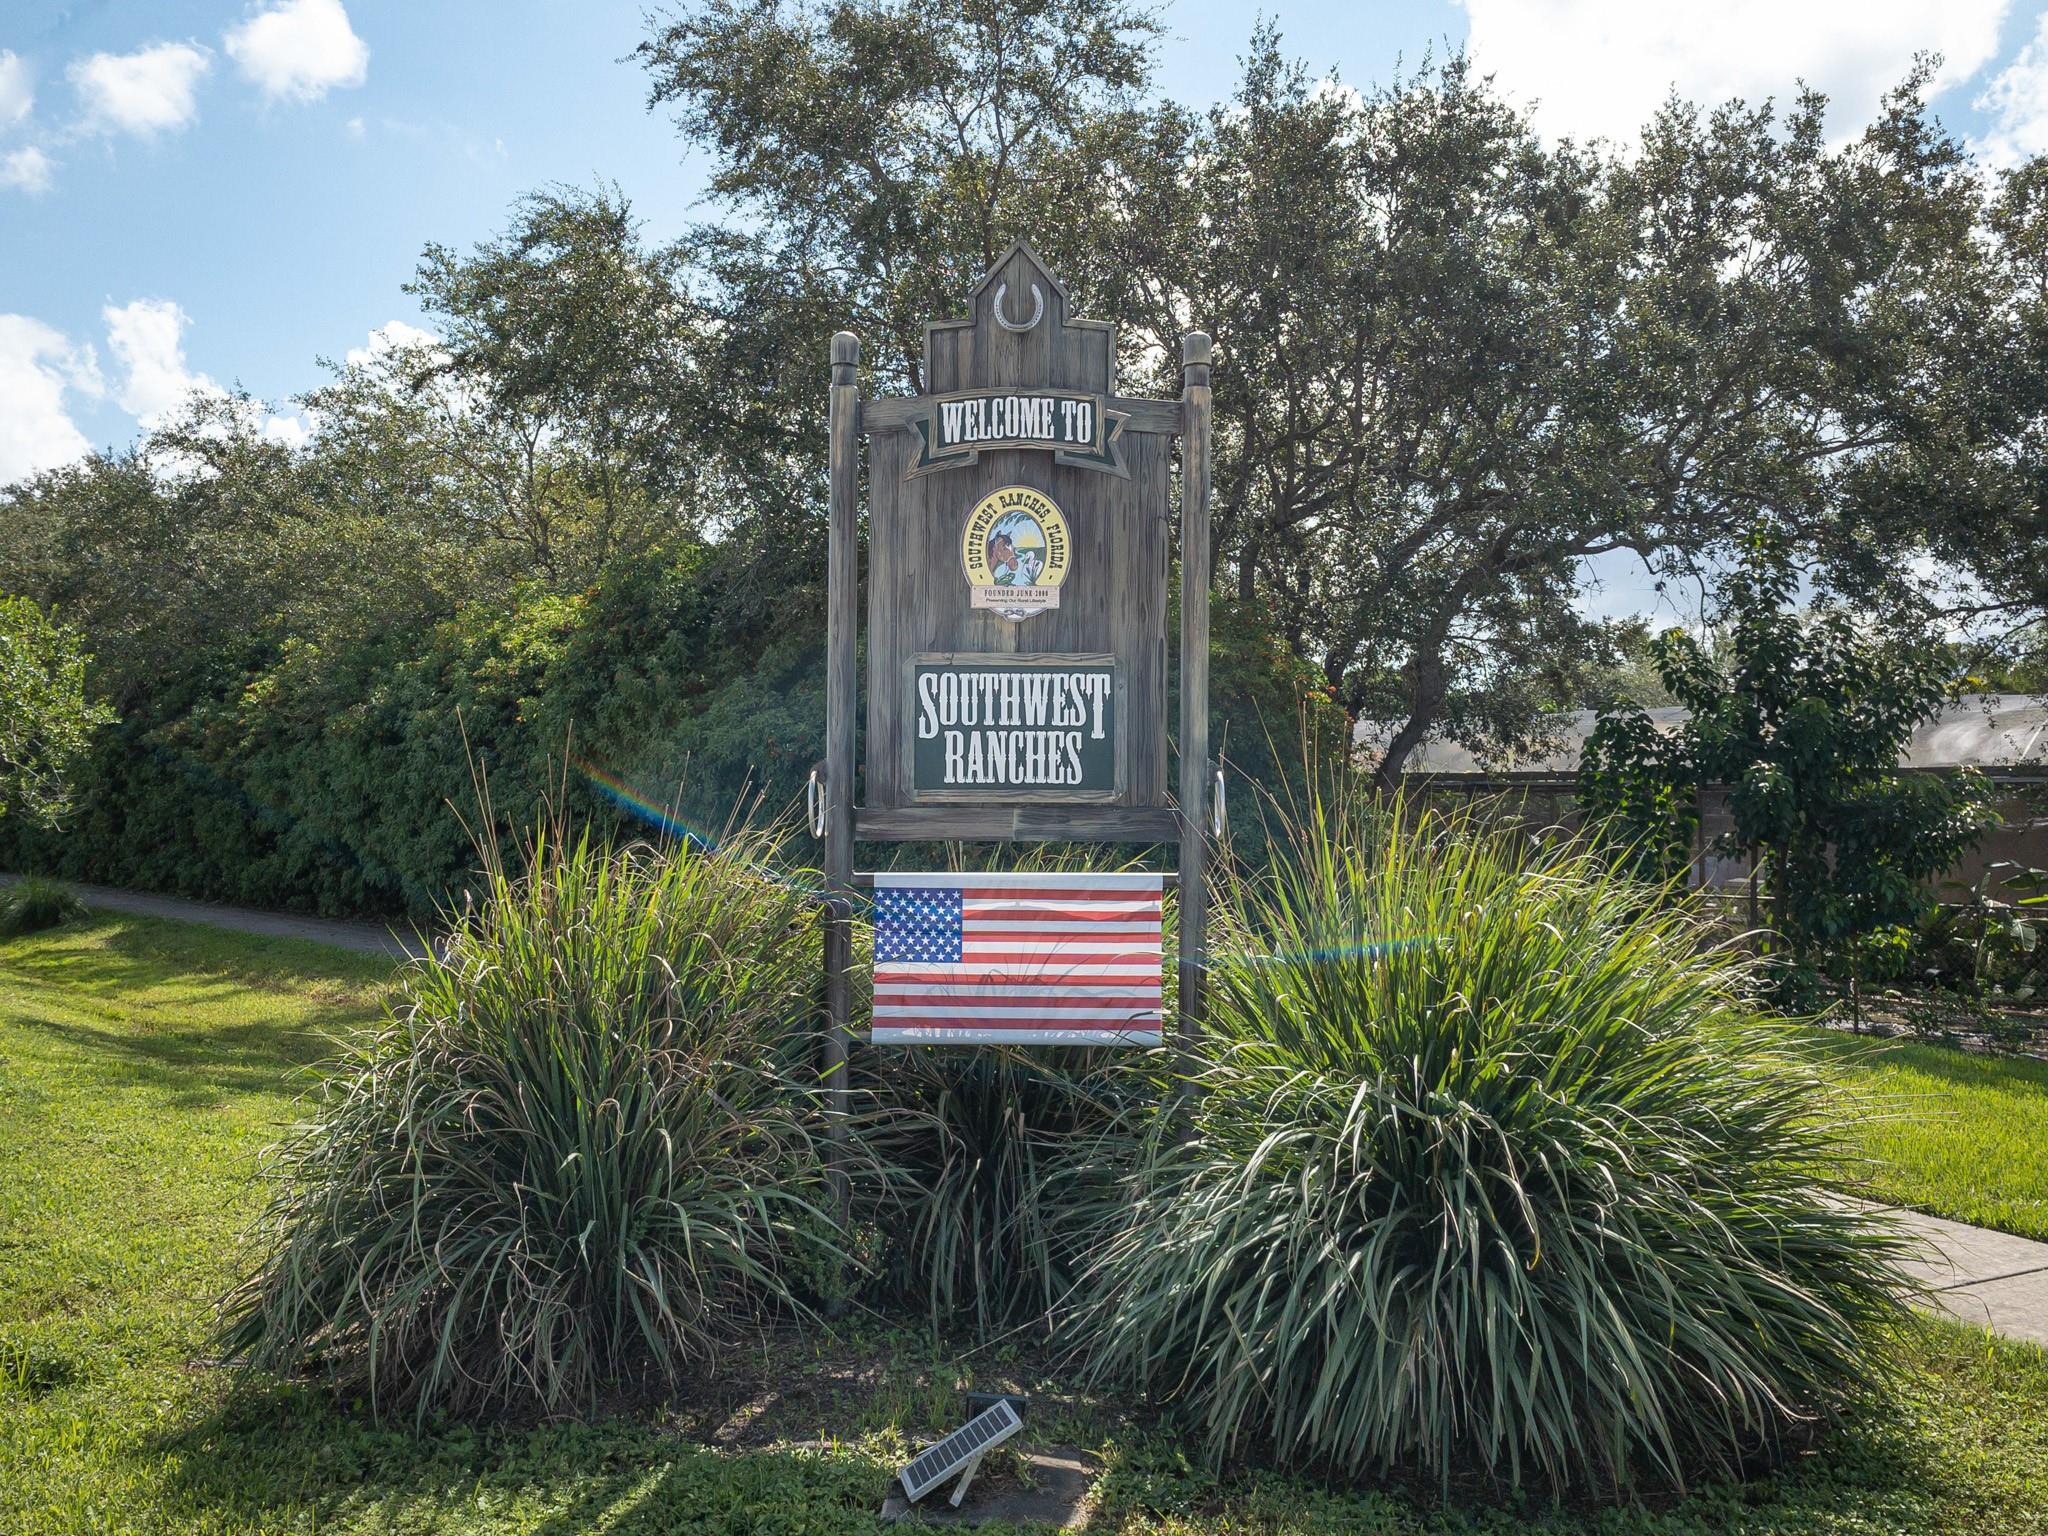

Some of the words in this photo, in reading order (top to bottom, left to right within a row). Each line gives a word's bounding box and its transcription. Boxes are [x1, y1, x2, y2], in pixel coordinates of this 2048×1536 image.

[941, 397, 1055, 443] WELCOME
[1061, 401, 1091, 443] TO
[968, 502, 998, 570] SOUTHWEST
[999, 493, 1051, 523] RANCHES,
[1046, 523, 1064, 569] FLORIDA
[984, 589, 1014, 597] FOUNDED
[1016, 589, 1033, 597] JUNE
[918, 672, 1111, 740] SOUTHWEST
[944, 730, 1083, 785] RANCHES
